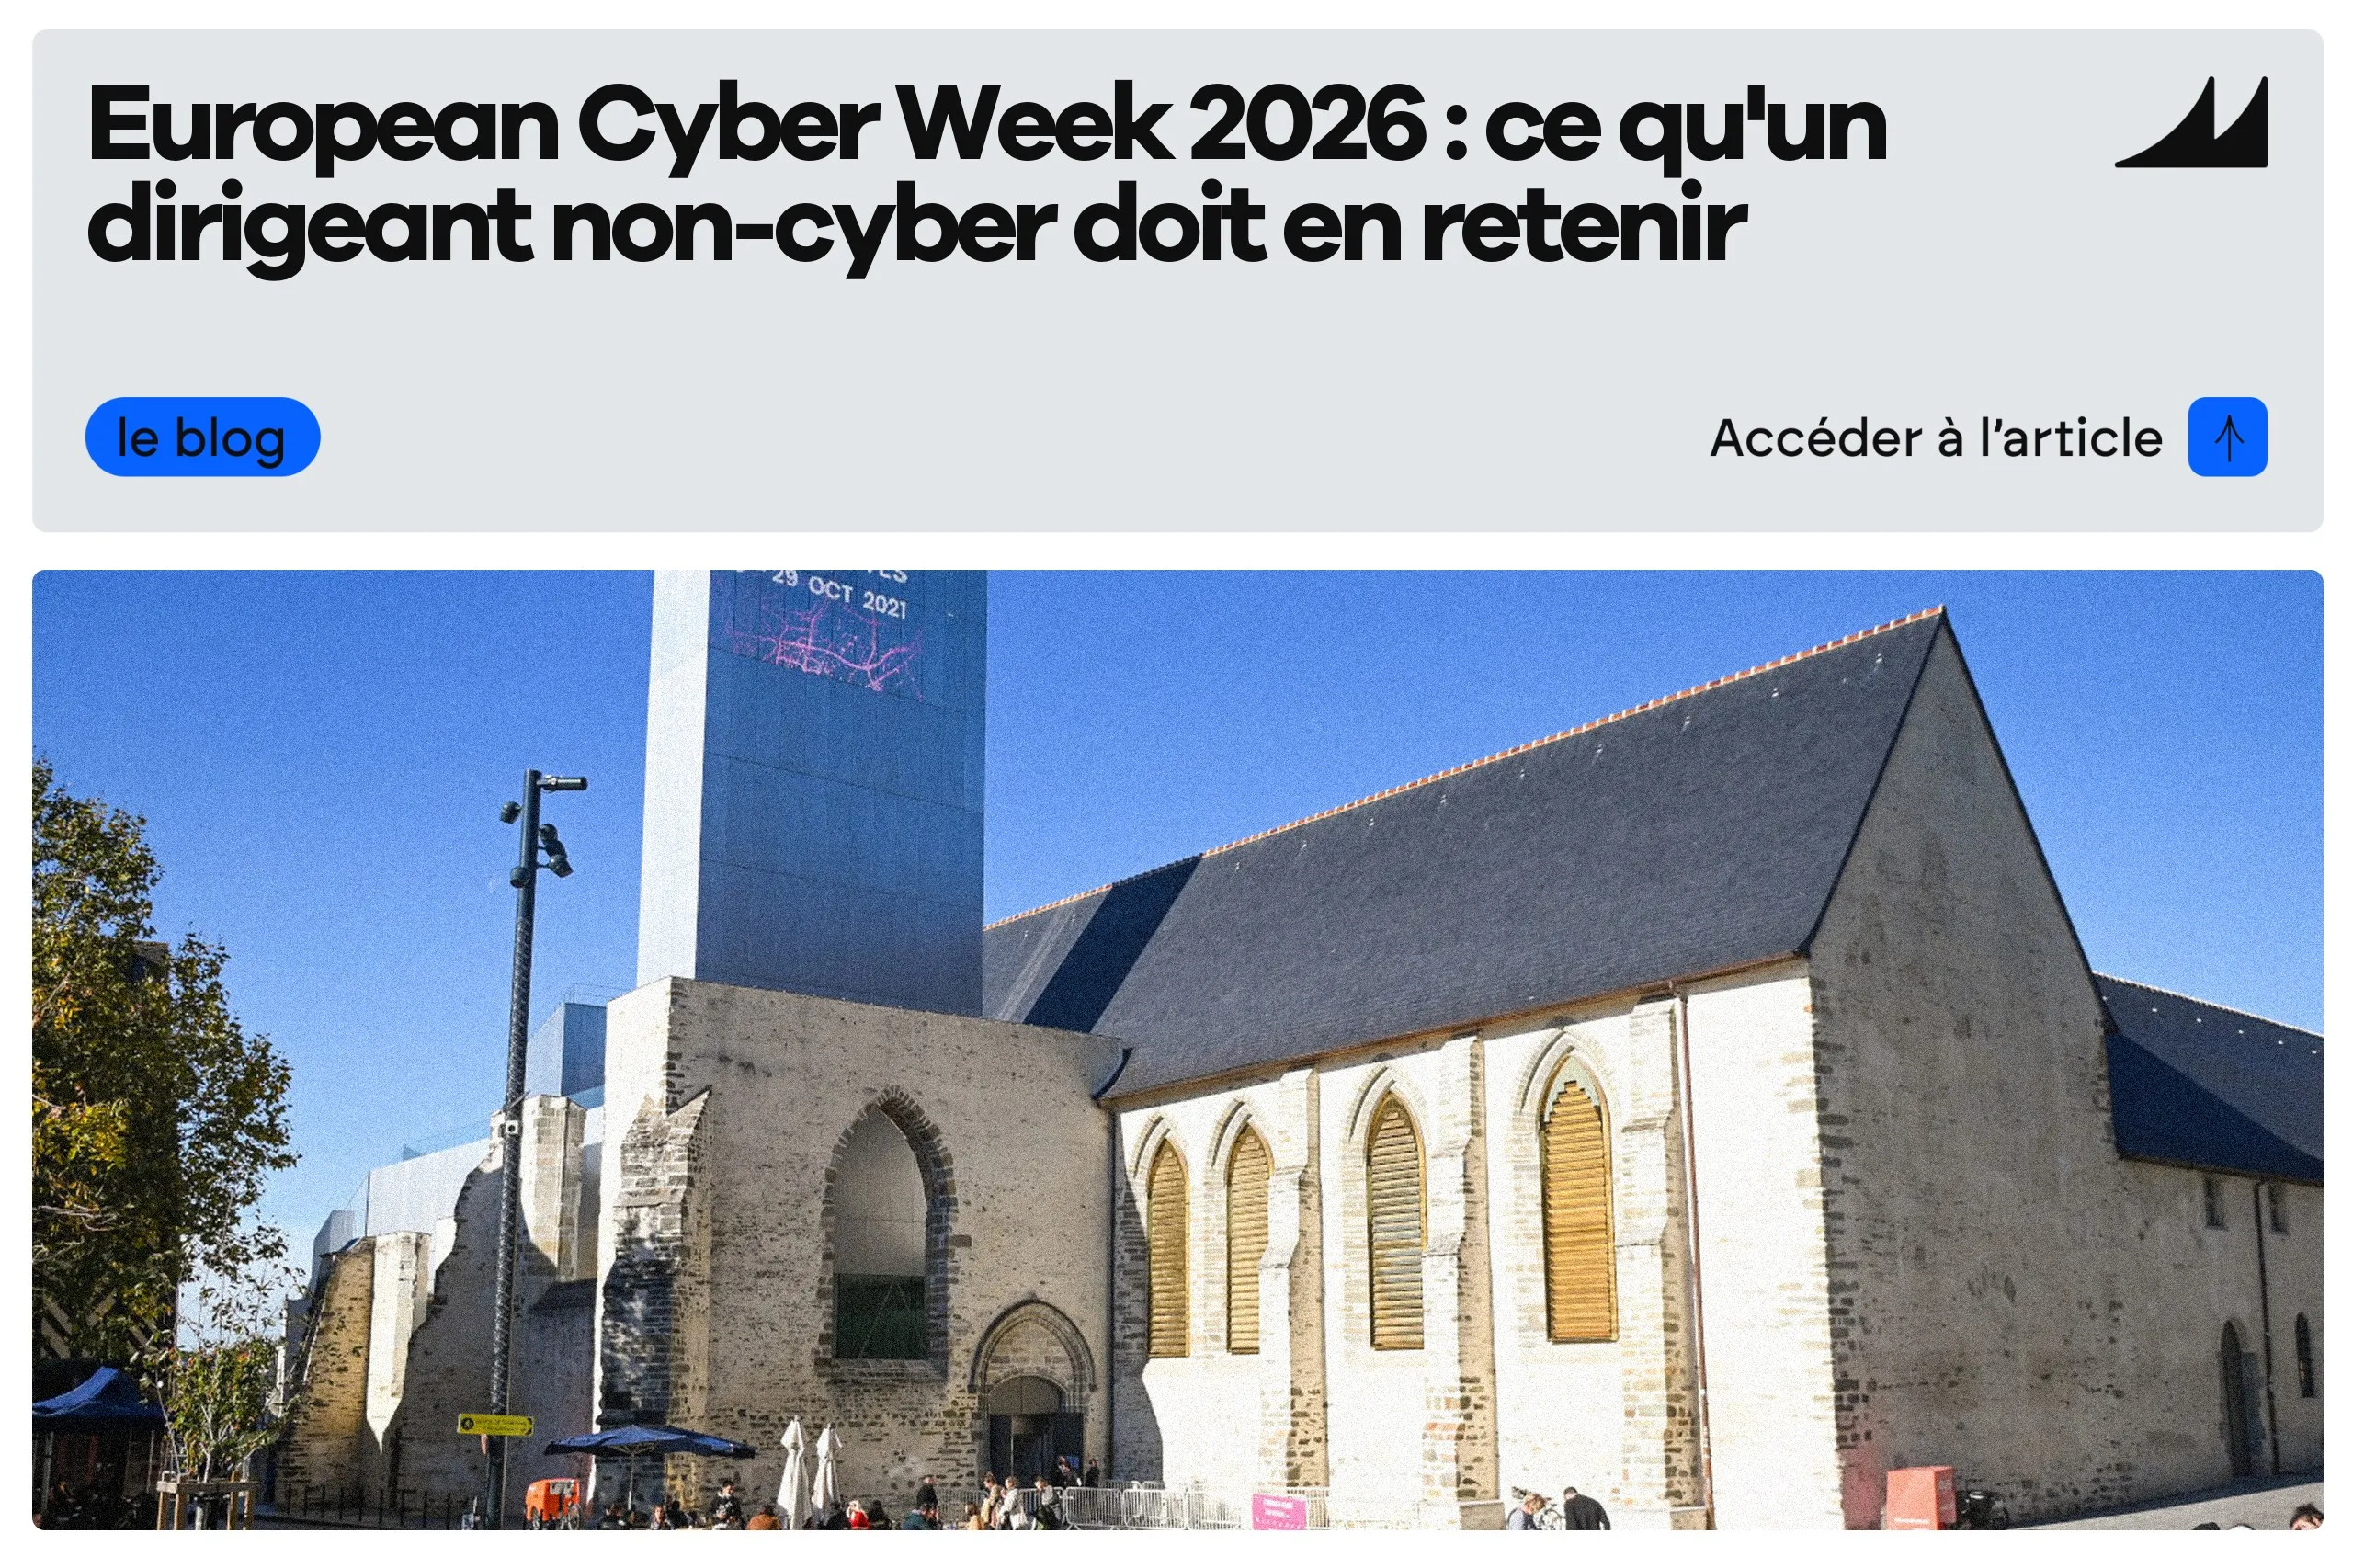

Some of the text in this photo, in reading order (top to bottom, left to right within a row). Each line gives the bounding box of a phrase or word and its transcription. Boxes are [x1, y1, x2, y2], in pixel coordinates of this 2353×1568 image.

[772, 570, 798, 587] 29
[808, 575, 853, 603] OCT
[863, 591, 907, 619] 2021
